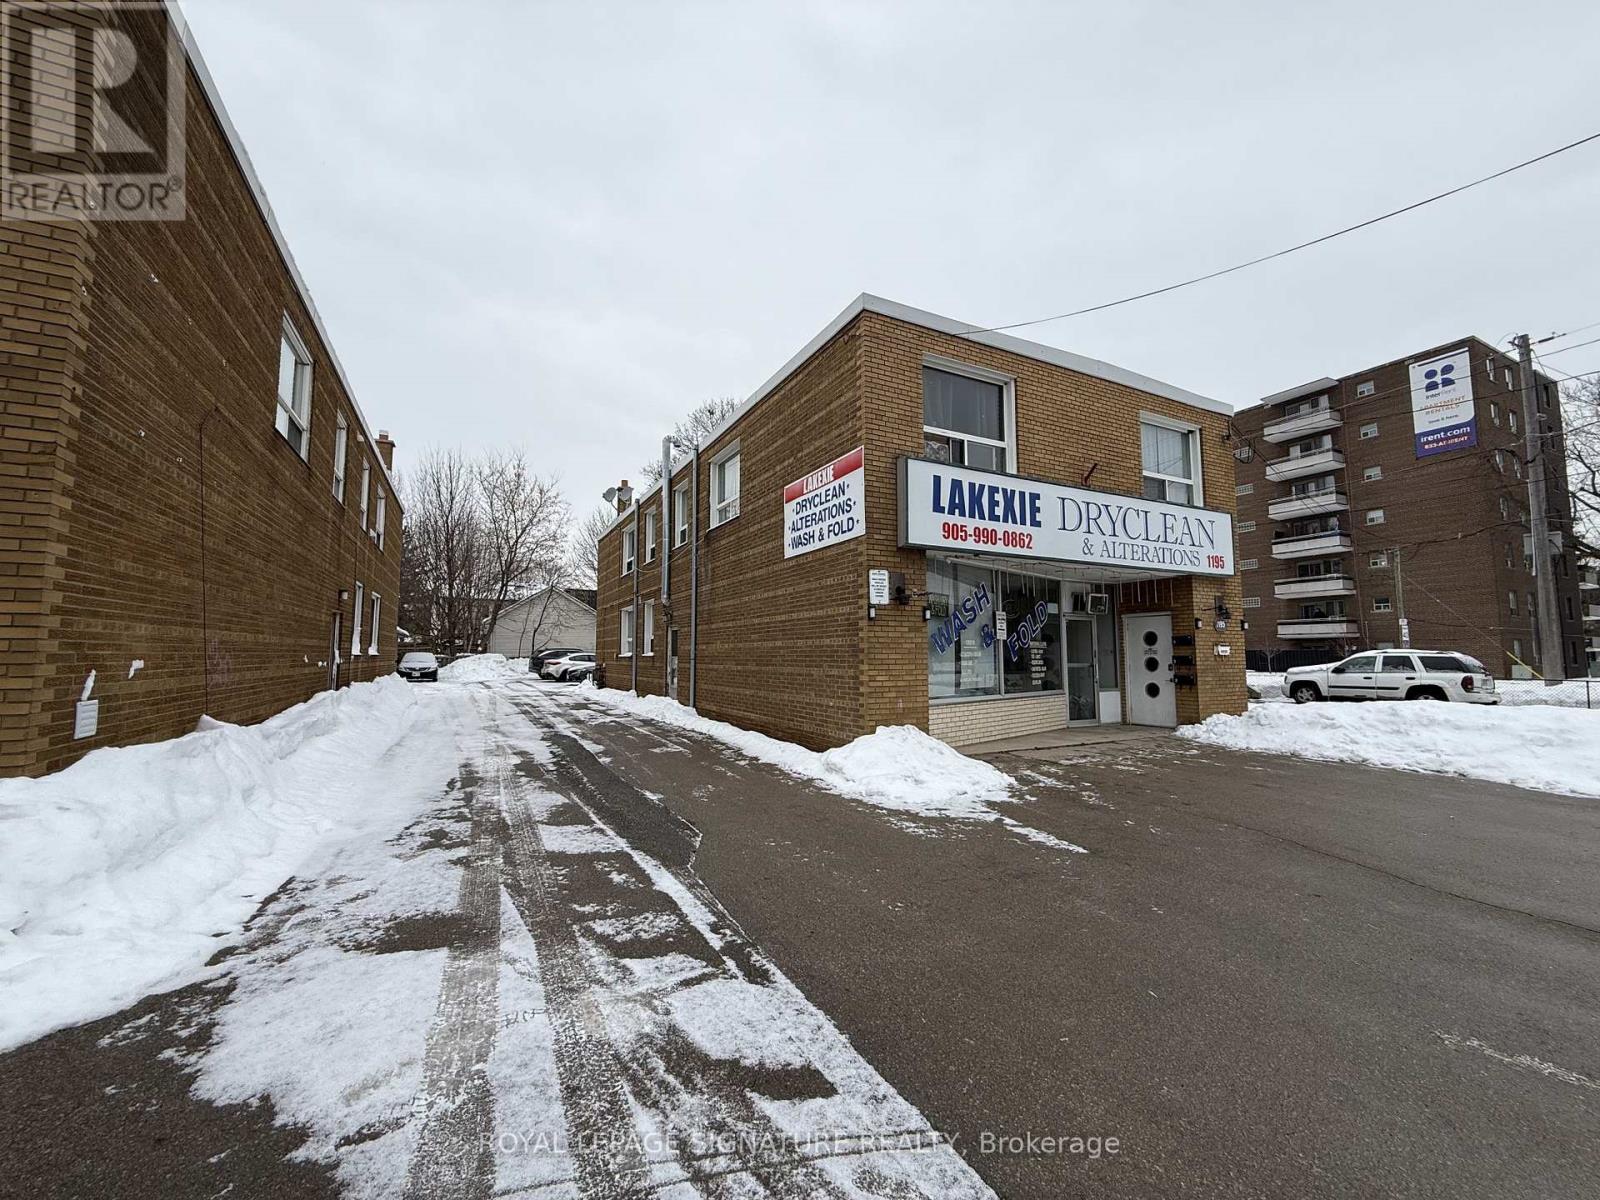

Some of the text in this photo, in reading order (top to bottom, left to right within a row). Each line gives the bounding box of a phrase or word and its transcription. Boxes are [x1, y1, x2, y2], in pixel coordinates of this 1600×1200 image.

[803, 465, 834, 494] LAKEXIE
[795, 481, 846, 515] DRYCLEAN
[933, 475, 1041, 528] LAKEXIE
[791, 498, 852, 534] ALTERATIONS
[1057, 496, 1215, 550] DRYCLEAN
[791, 517, 855, 550] WASH & FOLD
[942, 522, 1033, 549] 905-990-0862
[1082, 537, 1201, 567] & ALTERATIONS
[1206, 555, 1225, 569] 1195
[931, 582, 992, 655] WASH
[981, 623, 997, 649] &
[1007, 600, 1048, 662] FOLD
